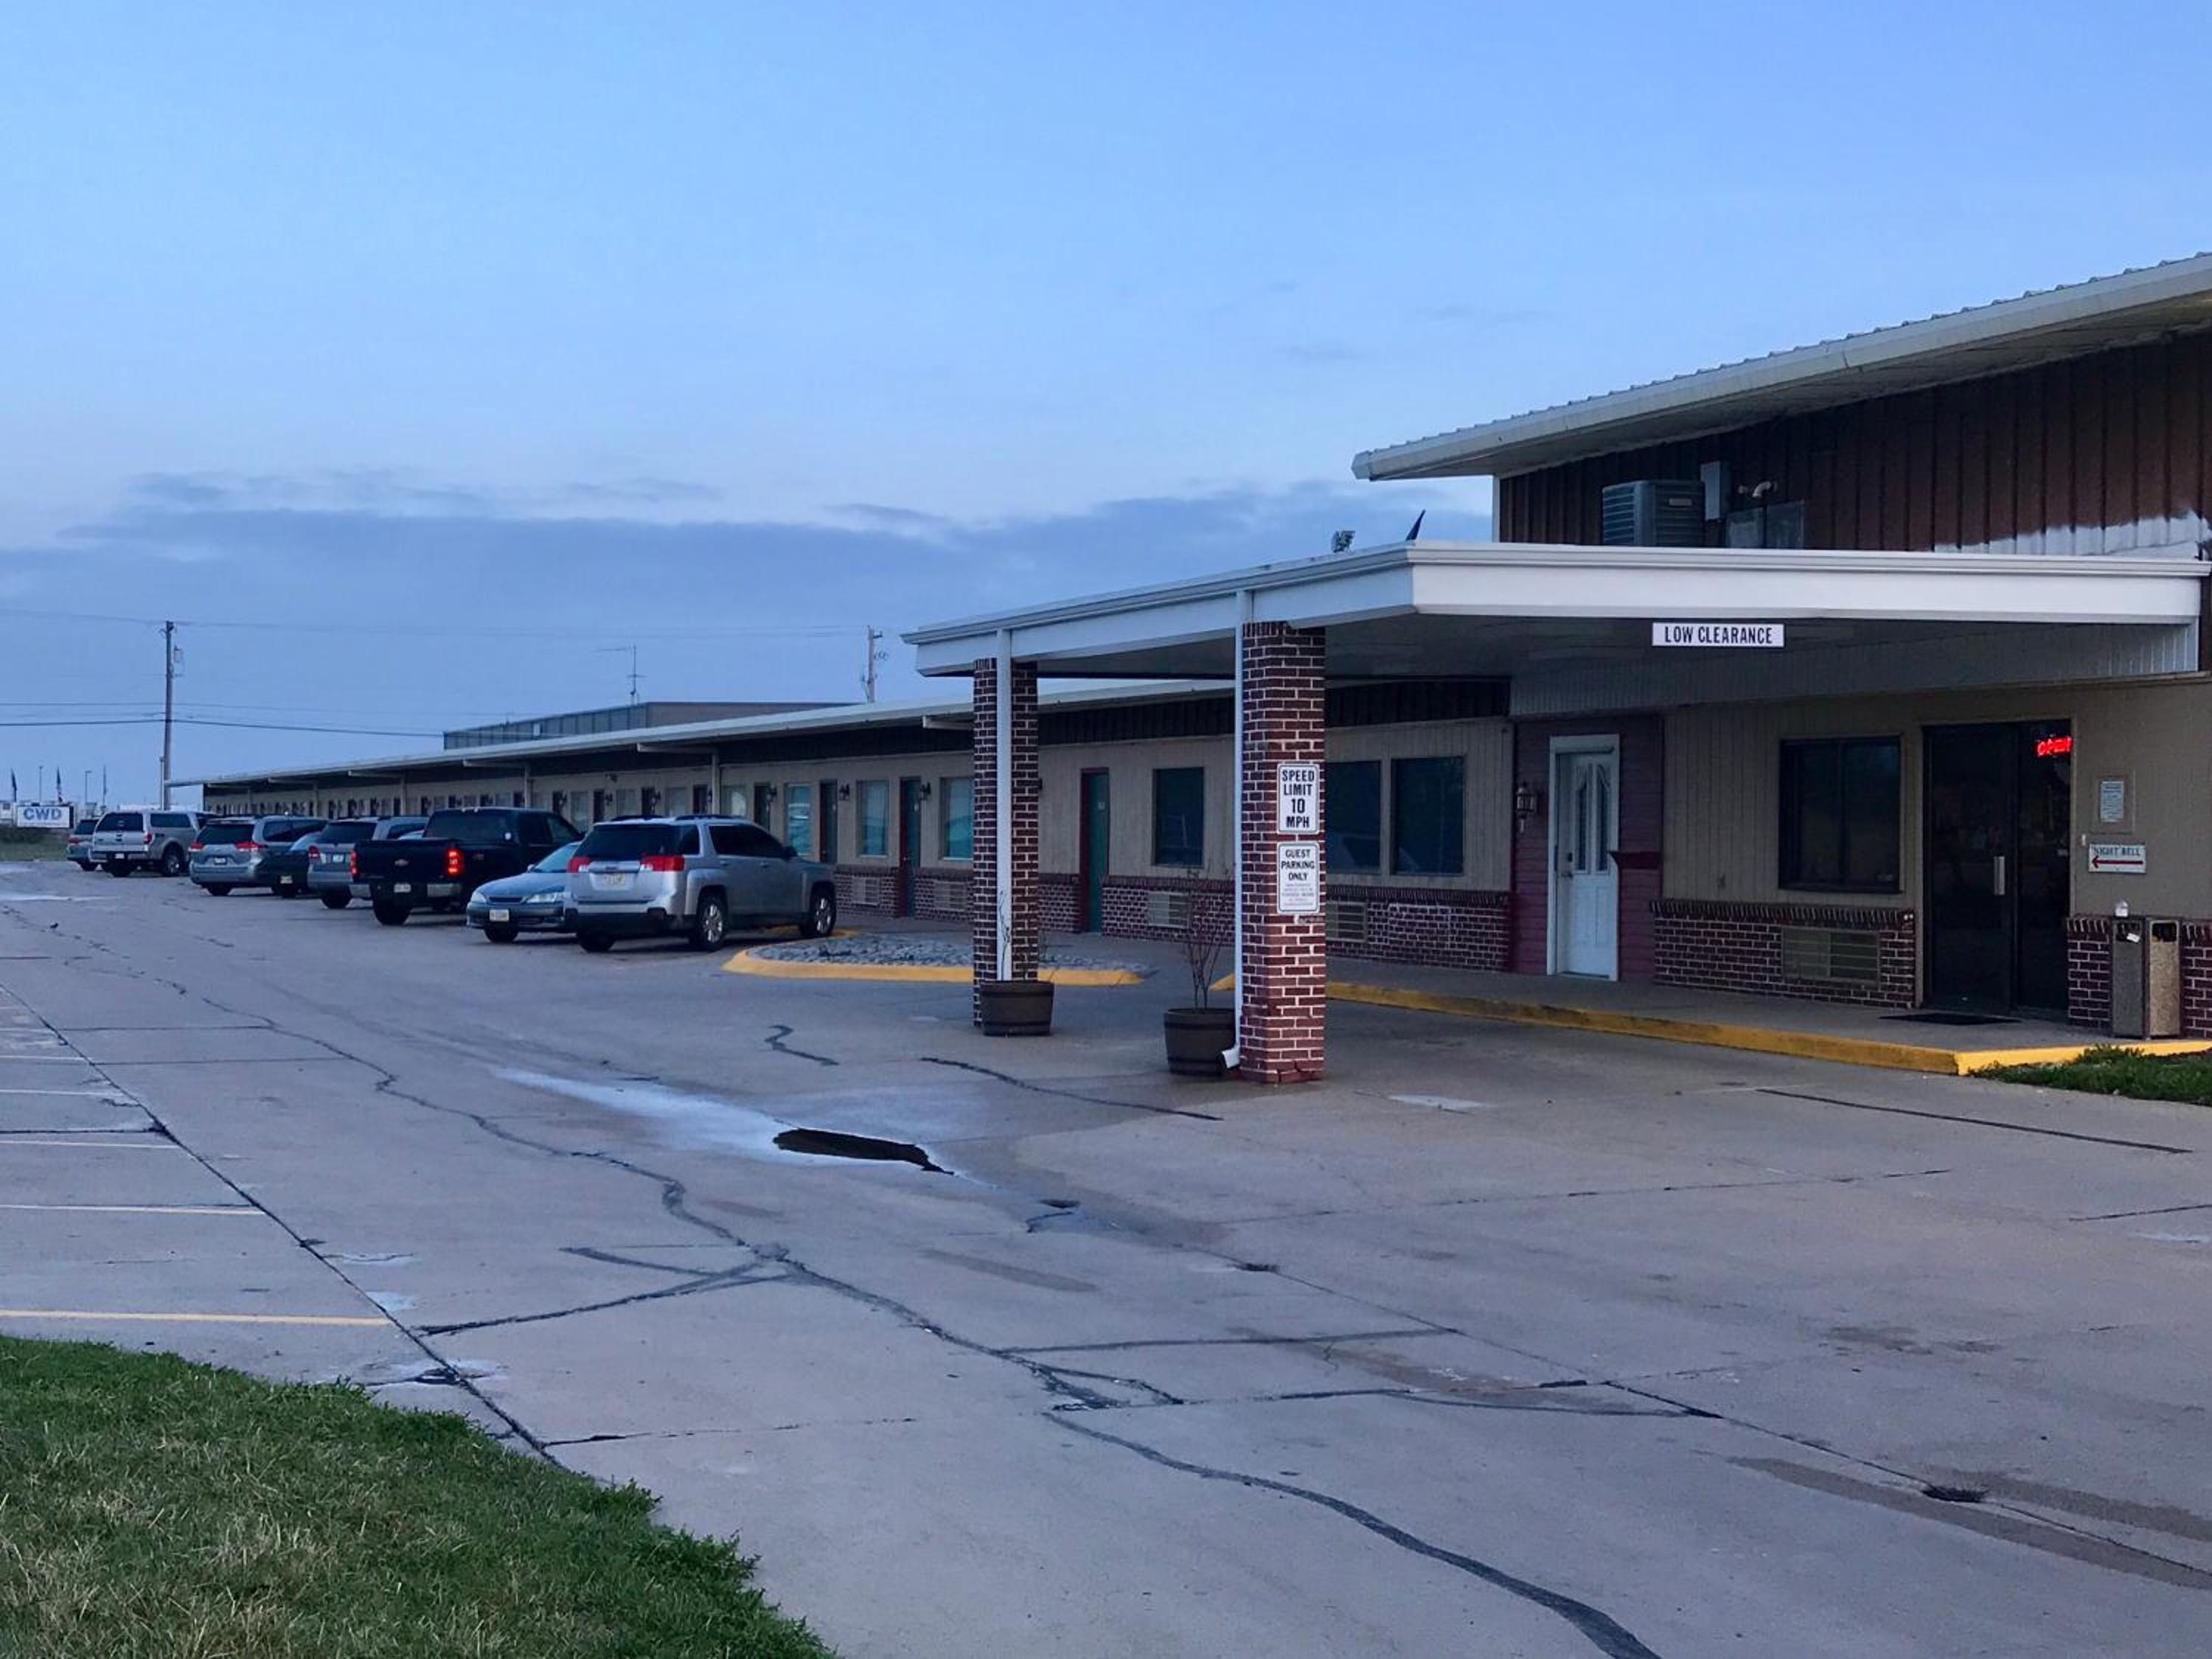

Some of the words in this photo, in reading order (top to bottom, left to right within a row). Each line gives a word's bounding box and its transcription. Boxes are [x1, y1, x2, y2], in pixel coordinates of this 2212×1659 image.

[1664, 625, 1693, 643] LOW
[1698, 626, 1773, 644] CLEARANCE
[2037, 737, 2072, 756] OPEN
[1281, 769, 1315, 782] SPEED
[1284, 784, 1312, 796] LIMIT
[1291, 799, 1305, 813] 10
[23, 807, 62, 820] CWD
[1286, 816, 1310, 828] MPH
[1285, 849, 1310, 858] GUEST
[2093, 846, 2119, 855] NIGHT
[2121, 846, 2141, 856] BELL
[1281, 860, 1315, 869] PARKING
[1288, 872, 1308, 881] ONLY
